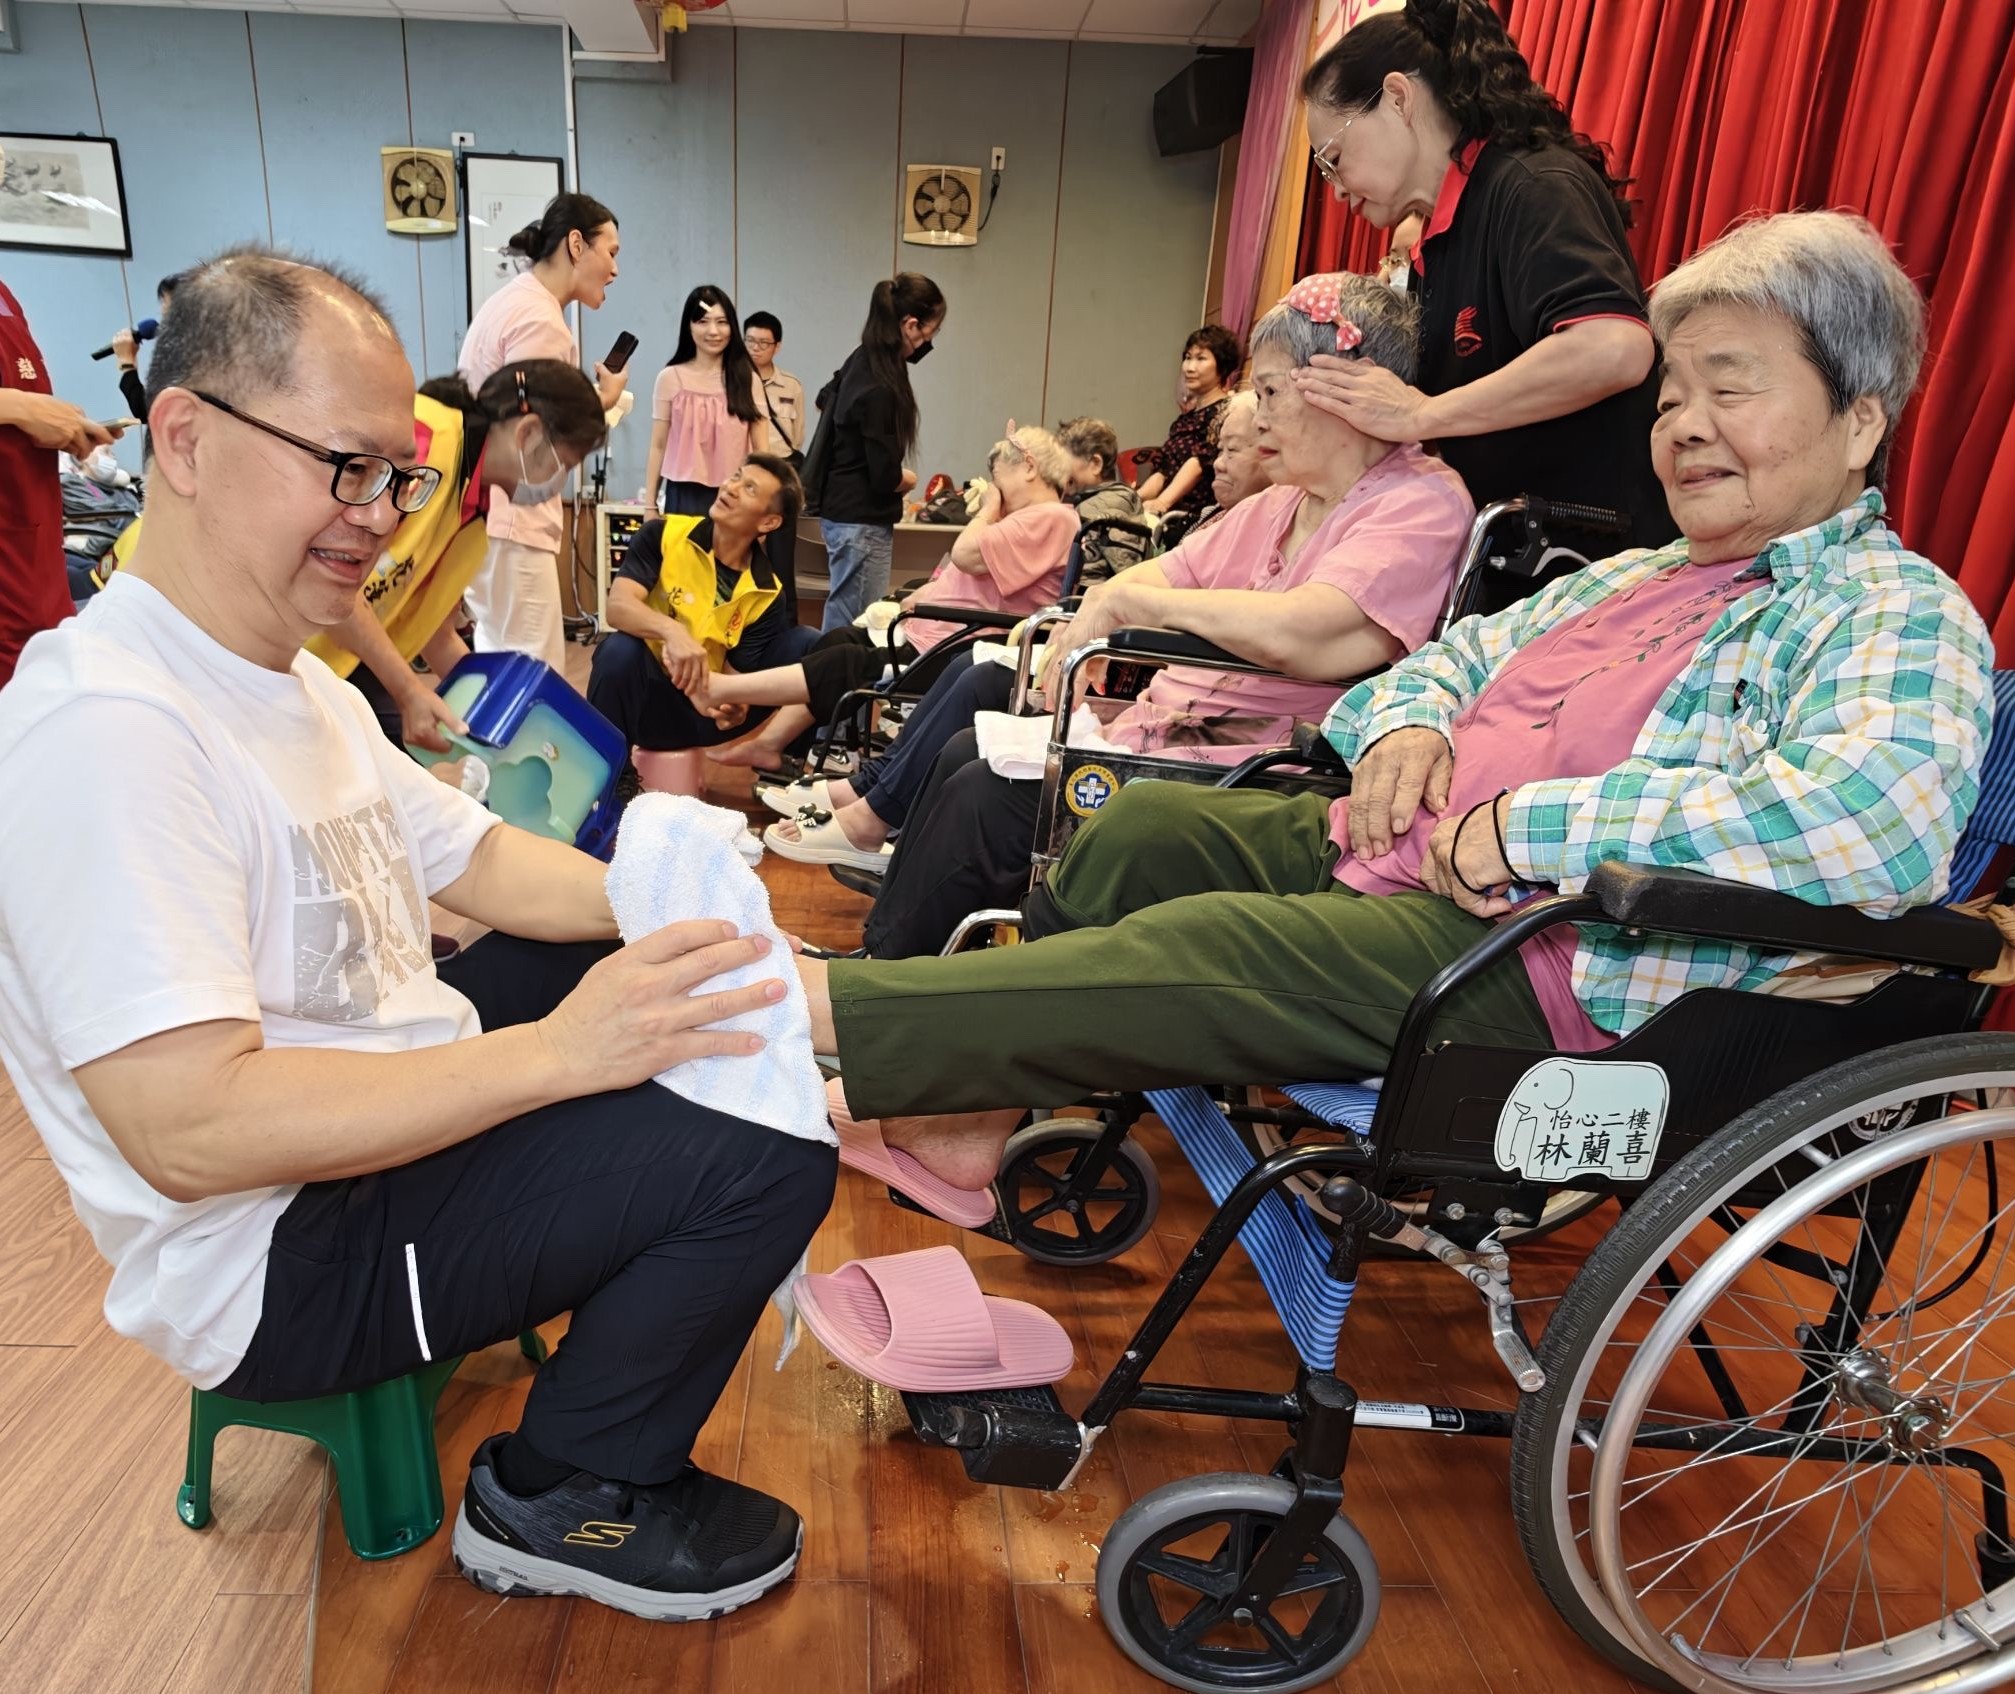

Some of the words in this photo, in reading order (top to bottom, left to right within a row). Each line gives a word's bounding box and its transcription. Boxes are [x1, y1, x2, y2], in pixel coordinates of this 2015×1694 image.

[1550, 1108, 1651, 1130] 怡心二樓
[1534, 1130, 1651, 1166] 林蘭喜
